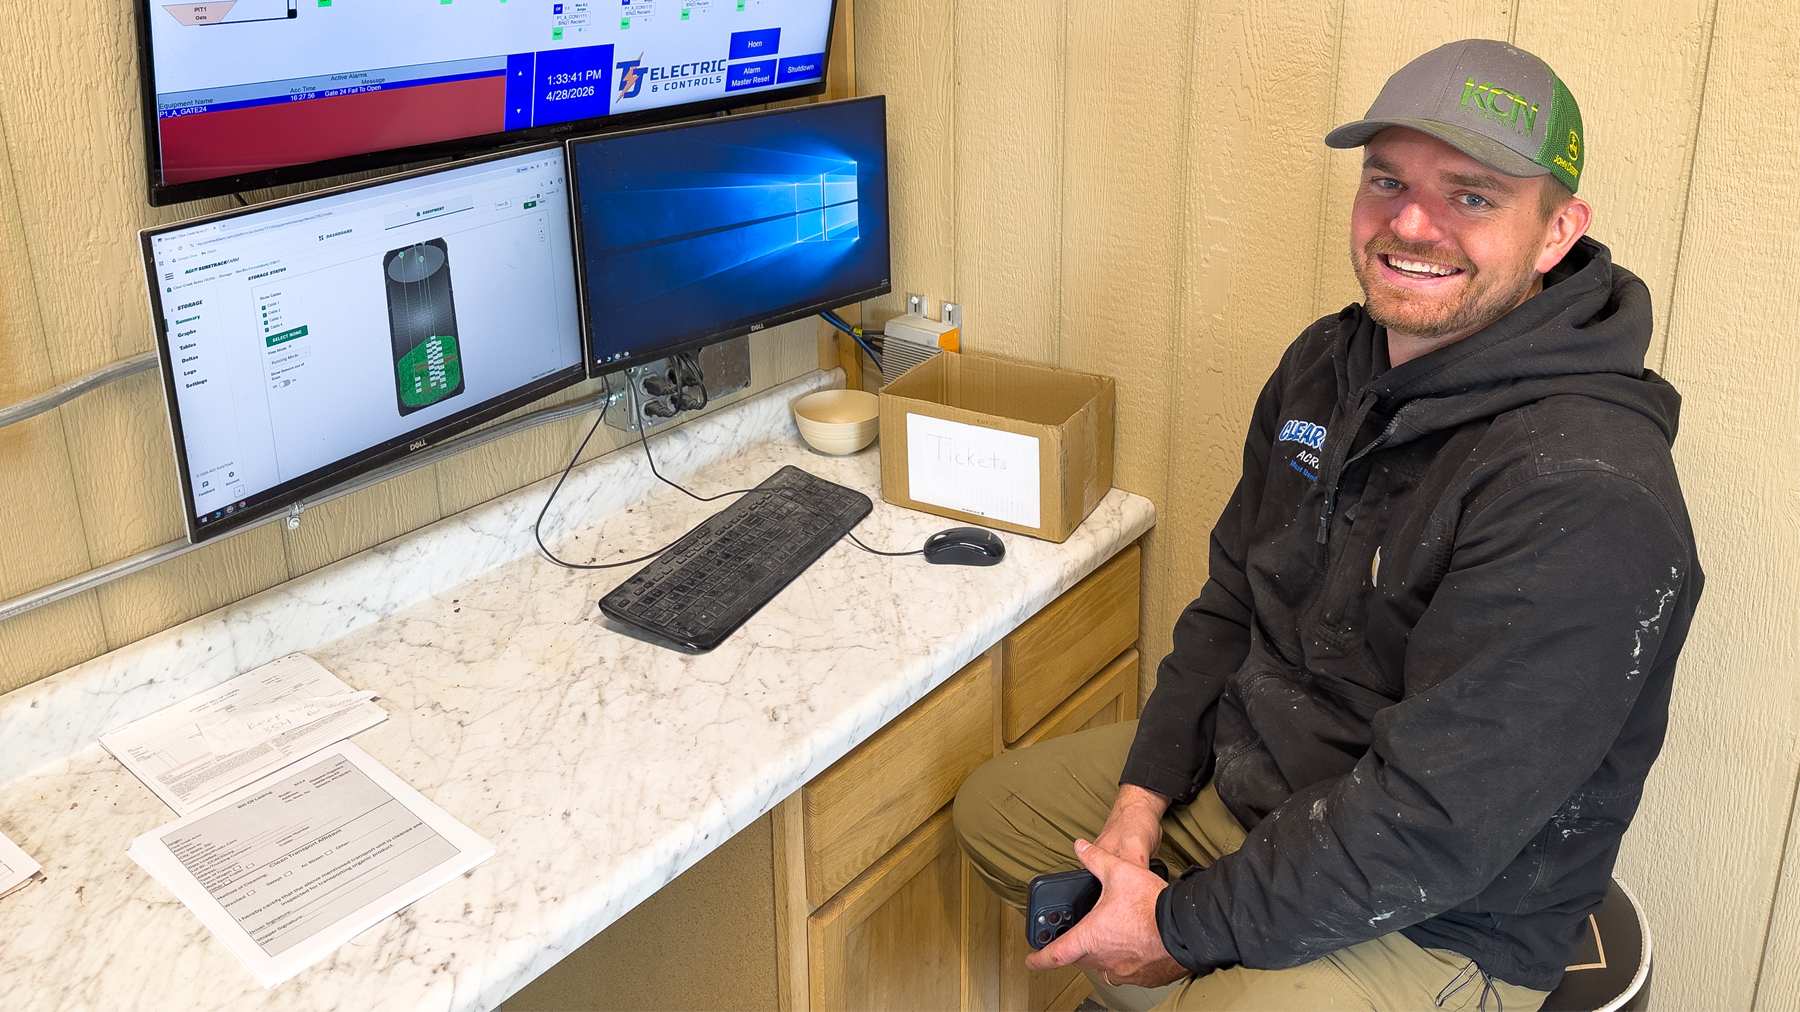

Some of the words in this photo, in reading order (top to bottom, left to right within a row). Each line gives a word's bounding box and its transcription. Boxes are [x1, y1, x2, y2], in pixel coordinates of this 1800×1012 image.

[650, 59, 727, 81] ELECTRIC
[788, 64, 814, 74] Shutdown
[547, 73, 582, 86] 1:33:41
[586, 69, 602, 80] PM
[732, 77, 752, 87] Master
[753, 75, 770, 84] Reset
[652, 84, 658, 93] &
[664, 76, 722, 91] CONTROLS
[546, 86, 594, 101] 4/28/2026
[160, 100, 193, 109] Equipment
[1460, 77, 1539, 131] KCN
[160, 106, 207, 117] P1_A_GATE24
[551, 124, 574, 133] SONY
[1554, 155, 1568, 169] JOHN
[423, 206, 444, 215] EQUIPMENT
[326, 228, 352, 238] DASHBOARD
[248, 272, 268, 281] STORAGE
[270, 267, 286, 275] STATUS
[177, 300, 203, 310] STORAGE
[175, 315, 200, 325] Summary
[751, 323, 764, 331] DELL
[178, 329, 196, 338] Graphs
[272, 334, 288, 343] SELECT
[186, 379, 208, 388] Settings
[1278, 420, 1327, 450] CLEAR
[410, 438, 427, 451] DELL
[925, 432, 1007, 470] Tickets
[1296, 450, 1319, 470] ACR
[1290, 460, 1302, 472] West
[1302, 468, 1318, 482] Bend
[254, 791, 272, 801] Lading
[269, 856, 289, 868] Clean
[288, 842, 318, 858] Transport
[317, 829, 342, 843] Affidavit
[242, 908, 262, 920] hereby
[262, 898, 281, 909] certify
[304, 877, 321, 887] above
[322, 861, 350, 877] mentioned
[351, 848, 375, 862] transport
[392, 828, 413, 840] cleaned
[281, 889, 310, 906] inspected
[319, 867, 352, 886] transporting
[352, 856, 372, 868] organic
[372, 844, 394, 857] product.
[225, 895, 246, 907] Washed
[266, 877, 282, 886] Swept
[309, 855, 324, 864] Blown
[218, 889, 237, 900] Method
[250, 925, 265, 934] Driver
[257, 930, 277, 942] Shipper
